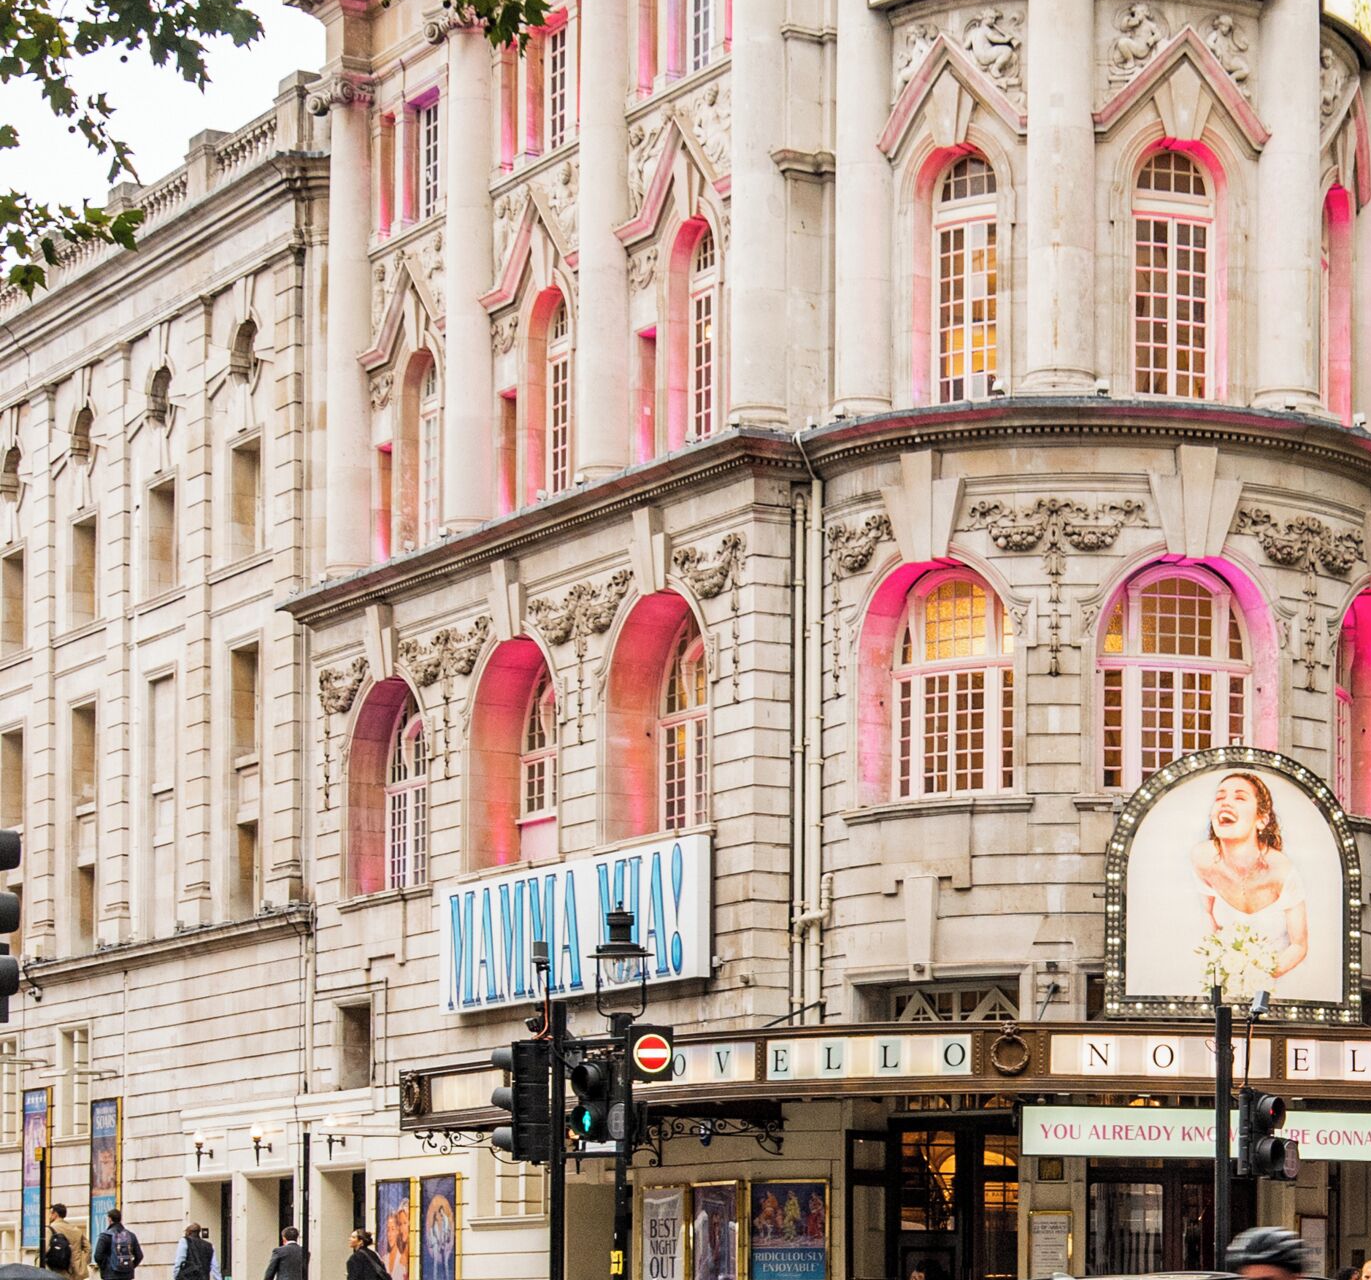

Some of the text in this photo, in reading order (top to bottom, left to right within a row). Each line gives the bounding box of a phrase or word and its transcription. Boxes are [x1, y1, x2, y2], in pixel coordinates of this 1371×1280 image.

[448, 870, 584, 1010] MAMMA
[671, 1041, 966, 1075] OVELLO
[1040, 1124, 1081, 1140] YOU
[1088, 1124, 1175, 1141] ALREADY
[649, 1218, 677, 1239] BEST
[649, 1239, 677, 1255] NIGHT
[649, 1256, 676, 1279] OUT
